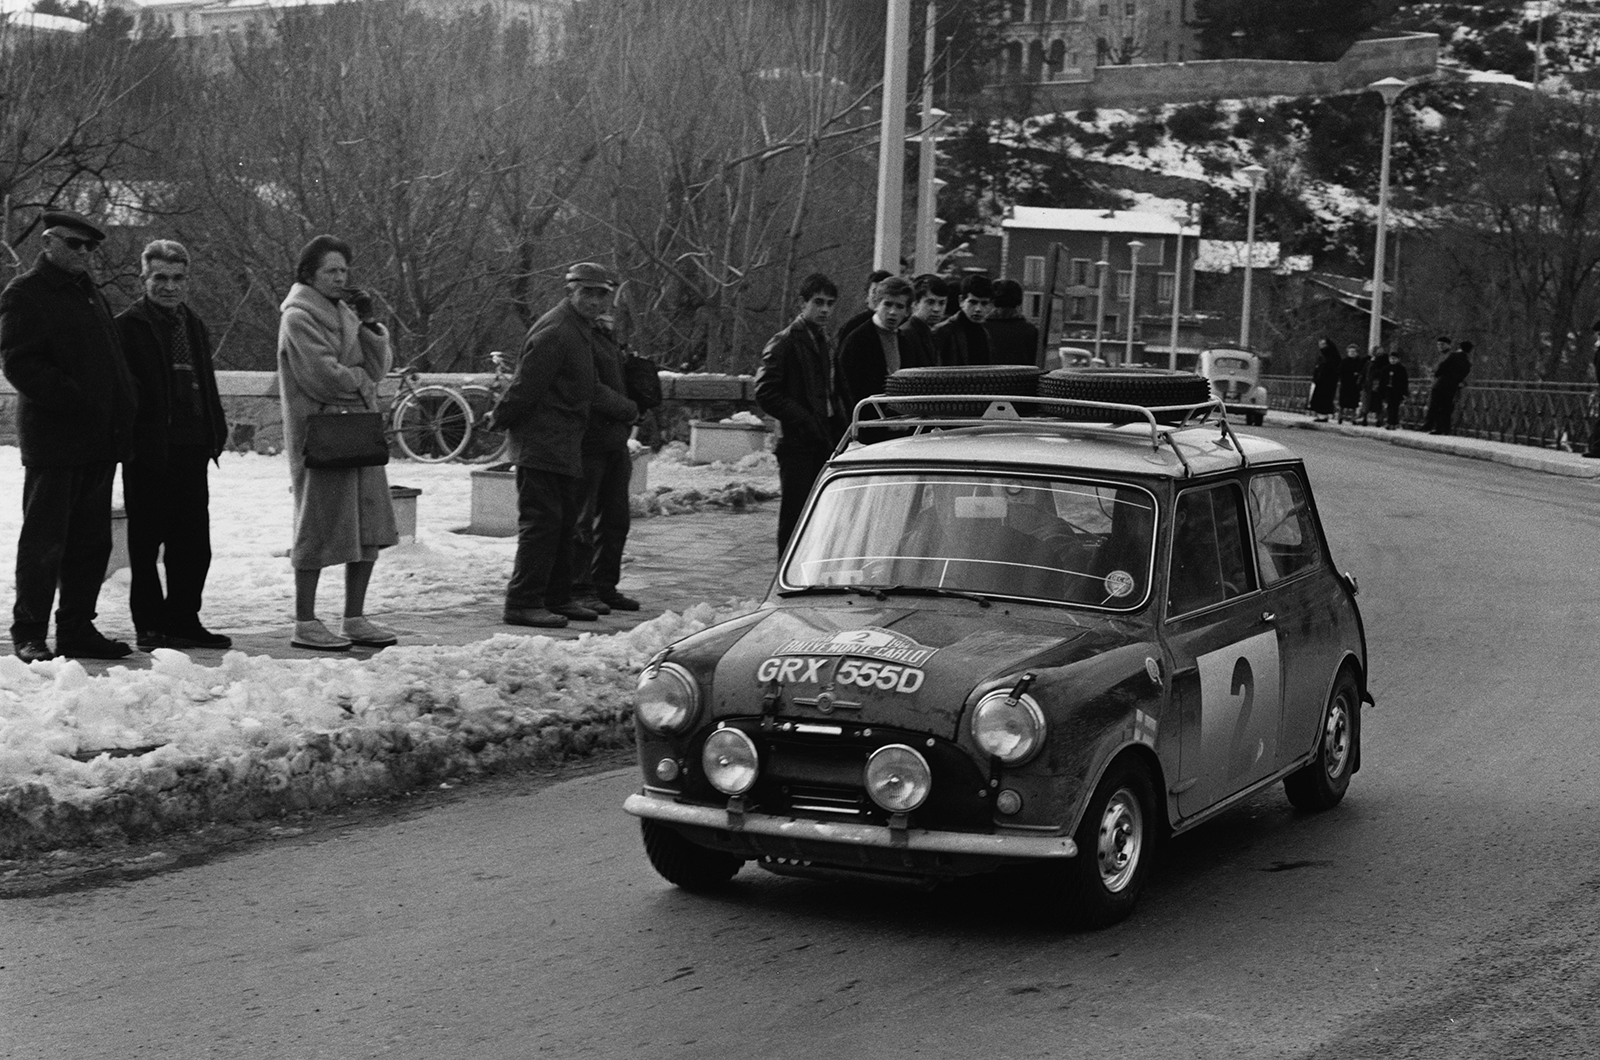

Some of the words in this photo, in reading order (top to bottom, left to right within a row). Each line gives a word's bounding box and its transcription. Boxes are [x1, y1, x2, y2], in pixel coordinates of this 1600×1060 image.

[781, 640, 829, 654] RALLYE
[851, 632, 871, 643] 2
[757, 658, 828, 683] GRX
[836, 660, 925, 694] 555D
[1229, 655, 1255, 782] 2
